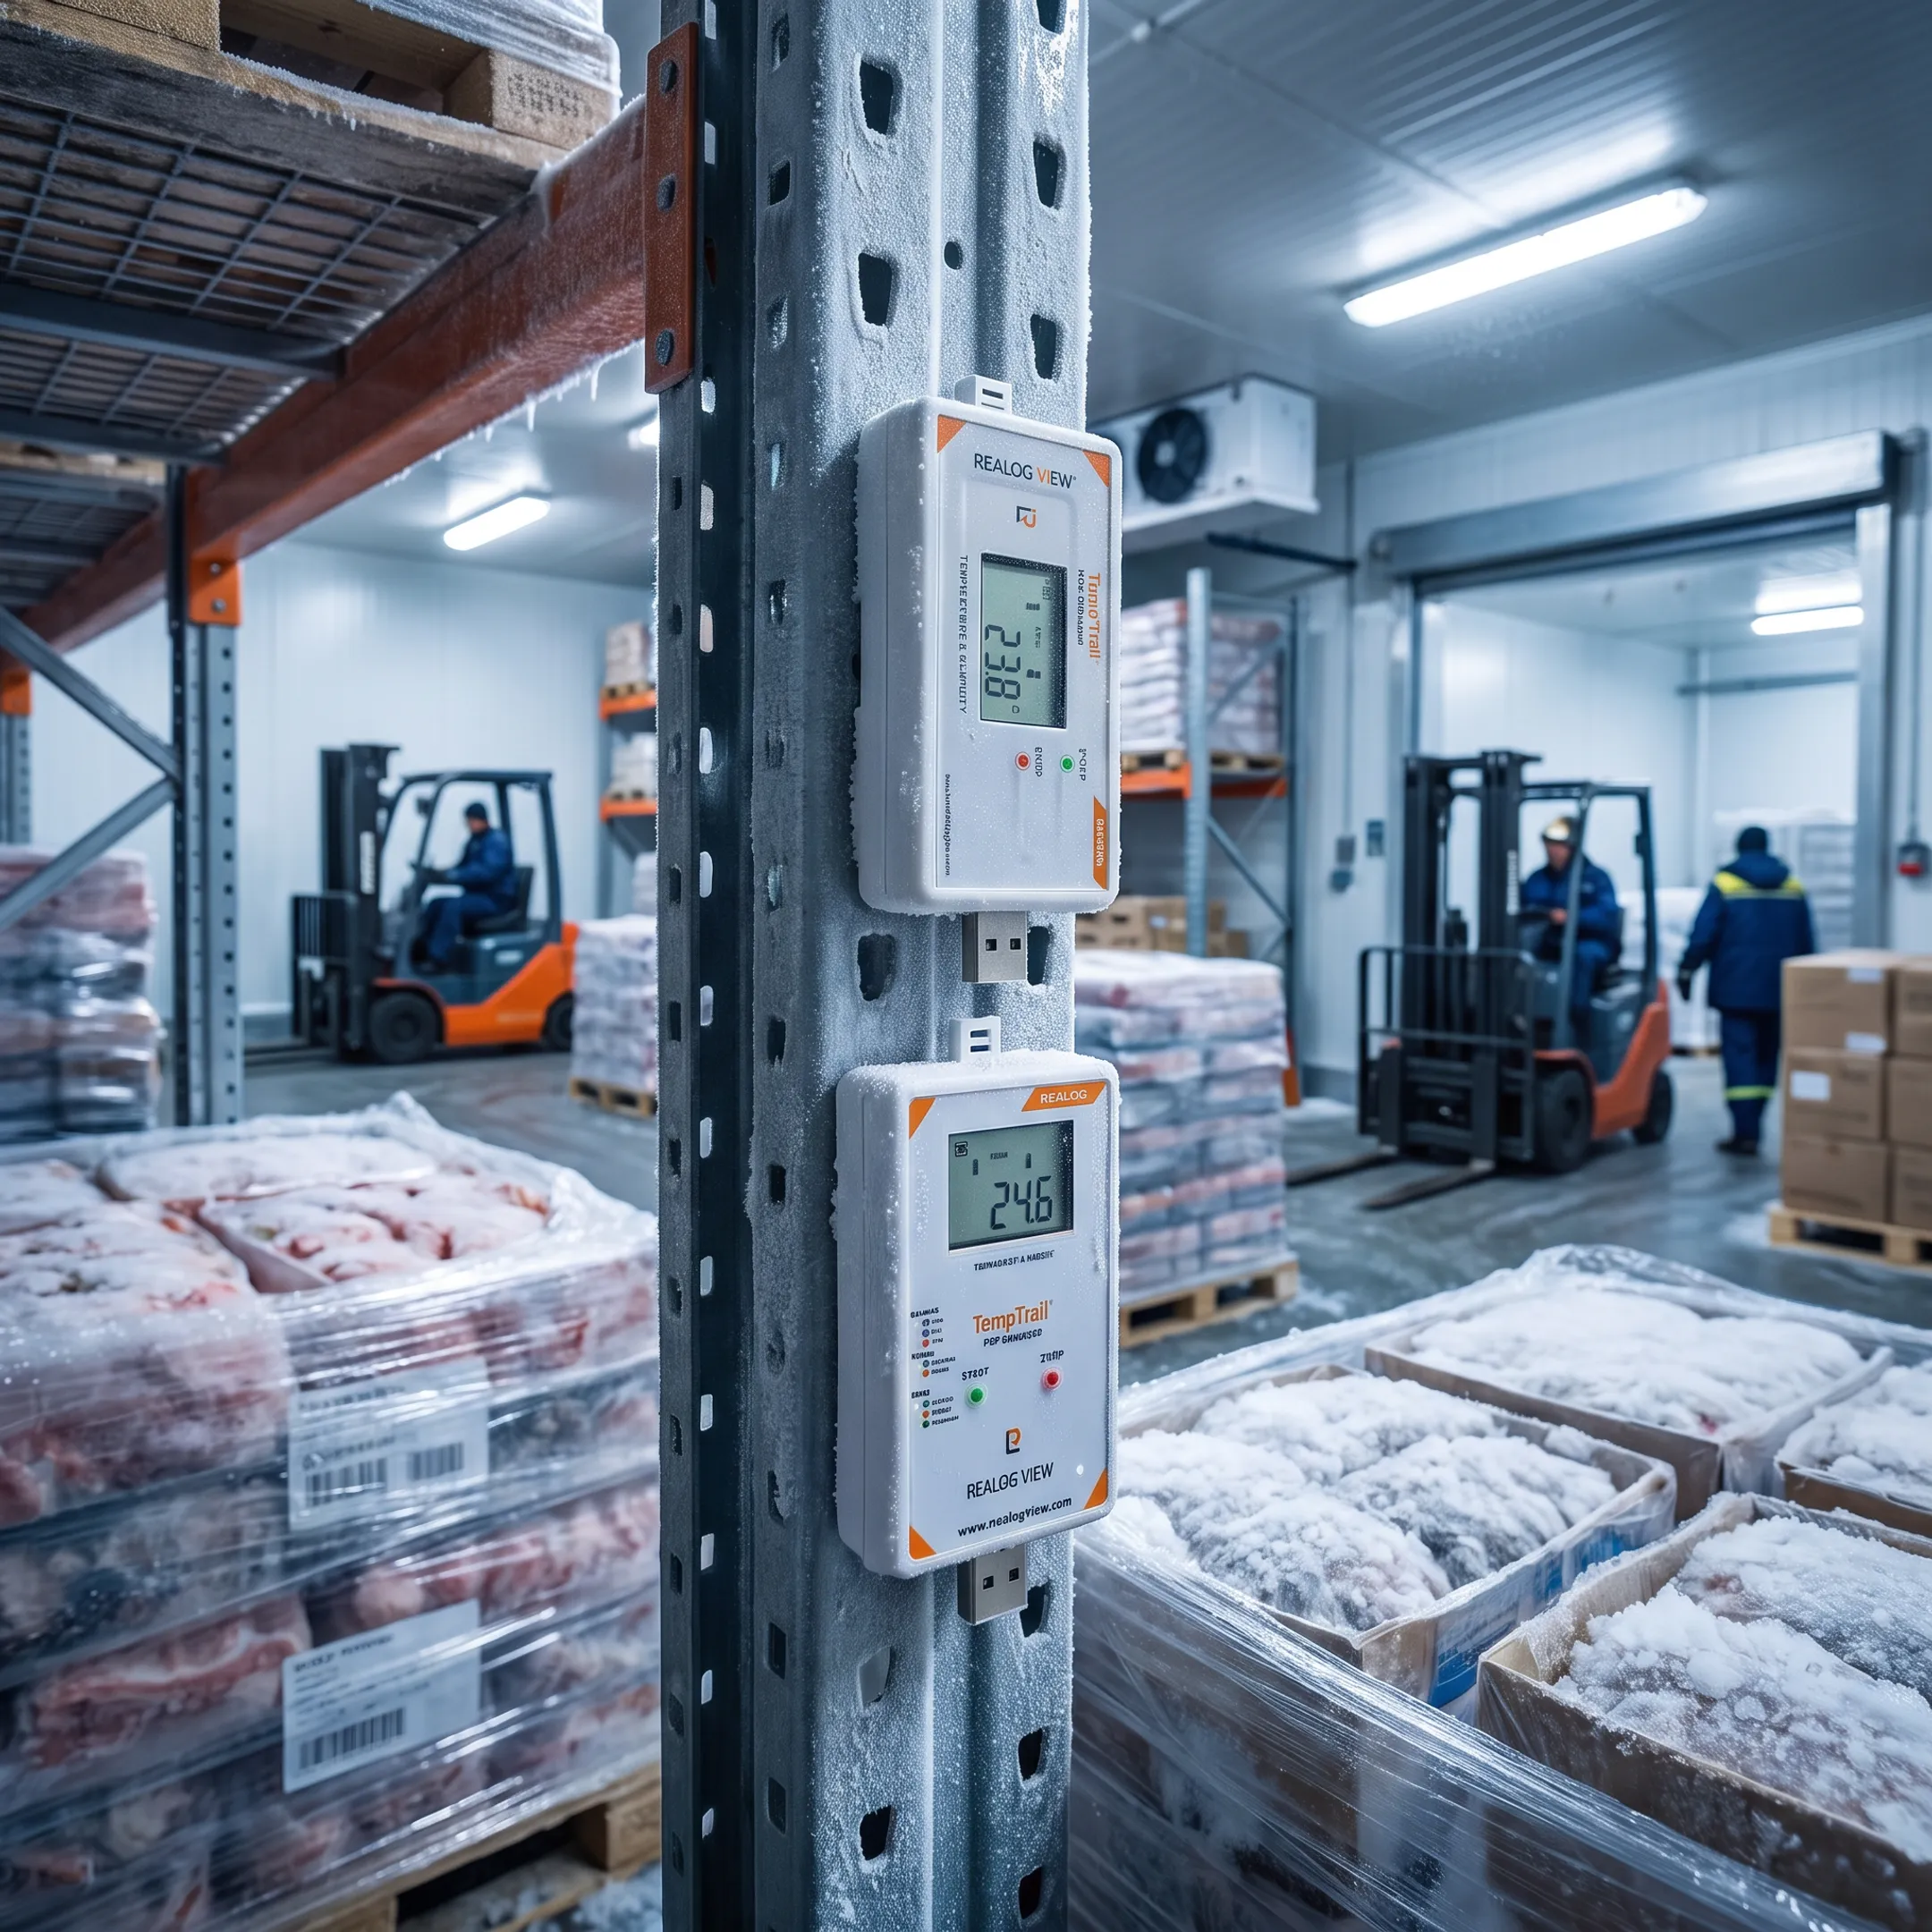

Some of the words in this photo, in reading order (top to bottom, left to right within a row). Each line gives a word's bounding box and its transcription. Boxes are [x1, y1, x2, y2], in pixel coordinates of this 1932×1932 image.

[974, 453, 1033, 480] REALOG
[1037, 467, 1072, 488] VIEW
[985, 624, 1021, 700] 23.8
[1040, 1089, 1088, 1104] REALOG
[990, 1175, 1052, 1230] 24.6
[973, 1300, 1048, 1334] TempTrail
[967, 1471, 1018, 1499] REALOG
[1021, 1462, 1054, 1484] VIEW
